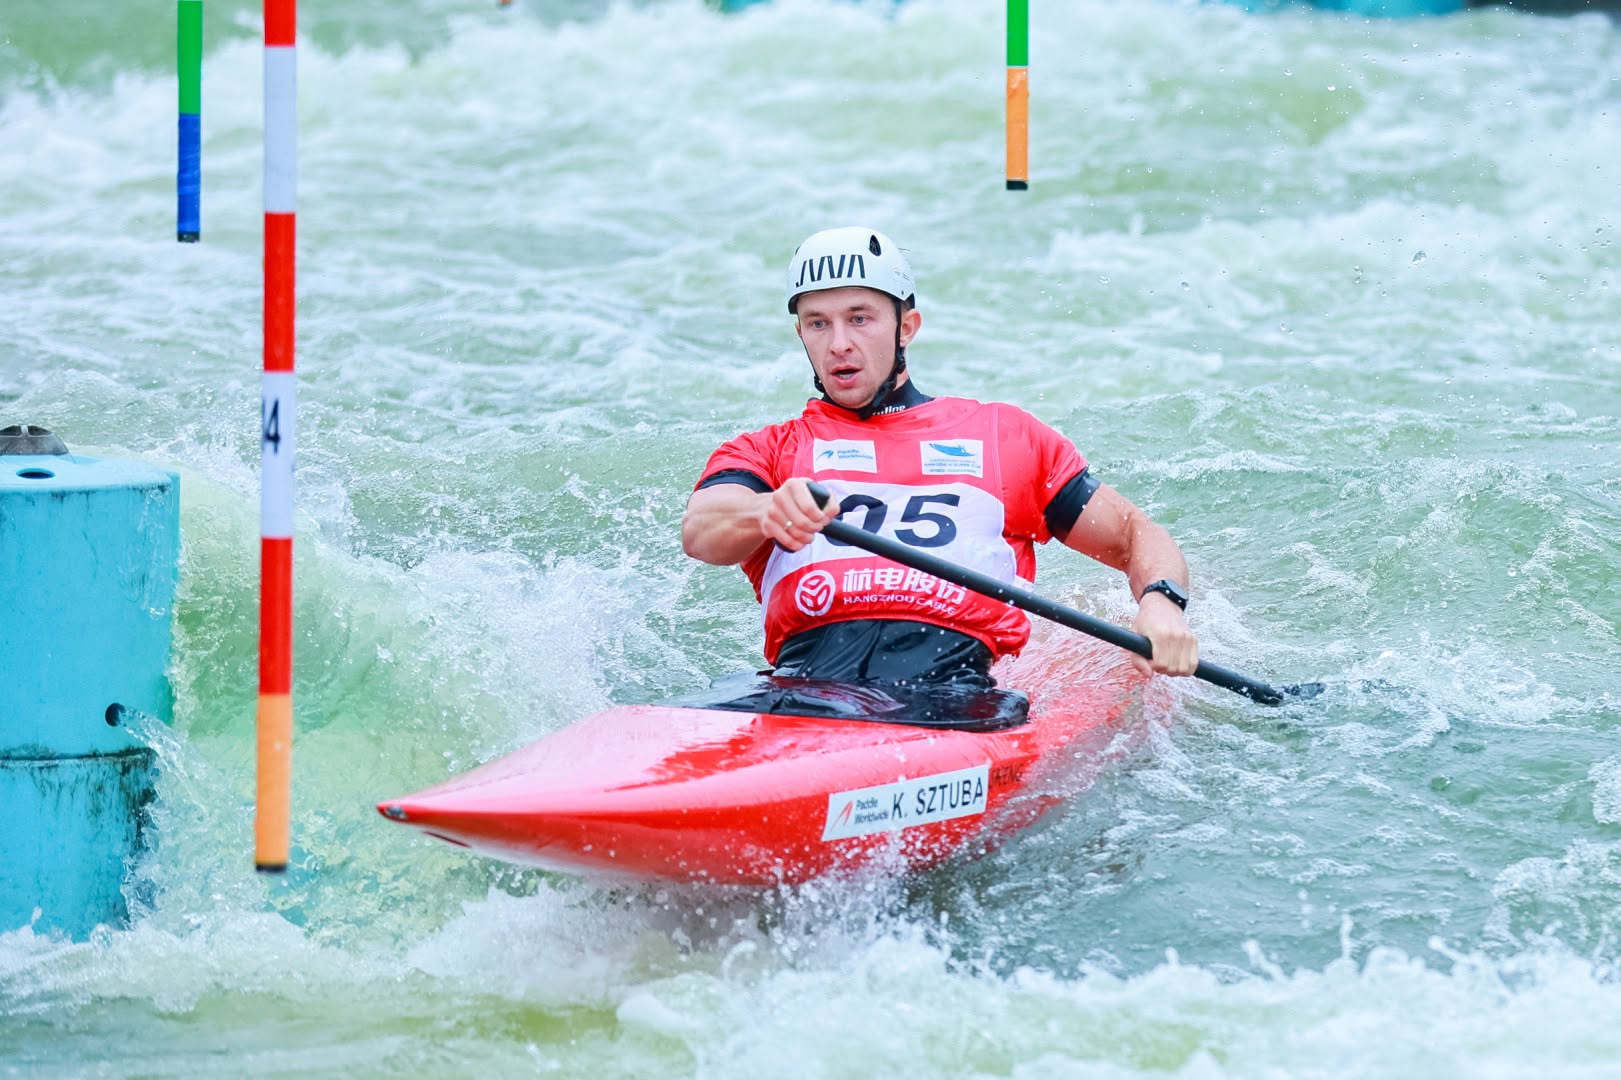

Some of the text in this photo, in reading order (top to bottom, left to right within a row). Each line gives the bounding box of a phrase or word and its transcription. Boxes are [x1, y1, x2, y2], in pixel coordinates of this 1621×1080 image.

[823, 493, 960, 548] 05
[843, 594, 957, 615] HANGZHOU CABLE
[856, 797, 879, 810] Paddle
[891, 777, 983, 820] K. SZTUBA
[855, 808, 889, 824] Worldwide
